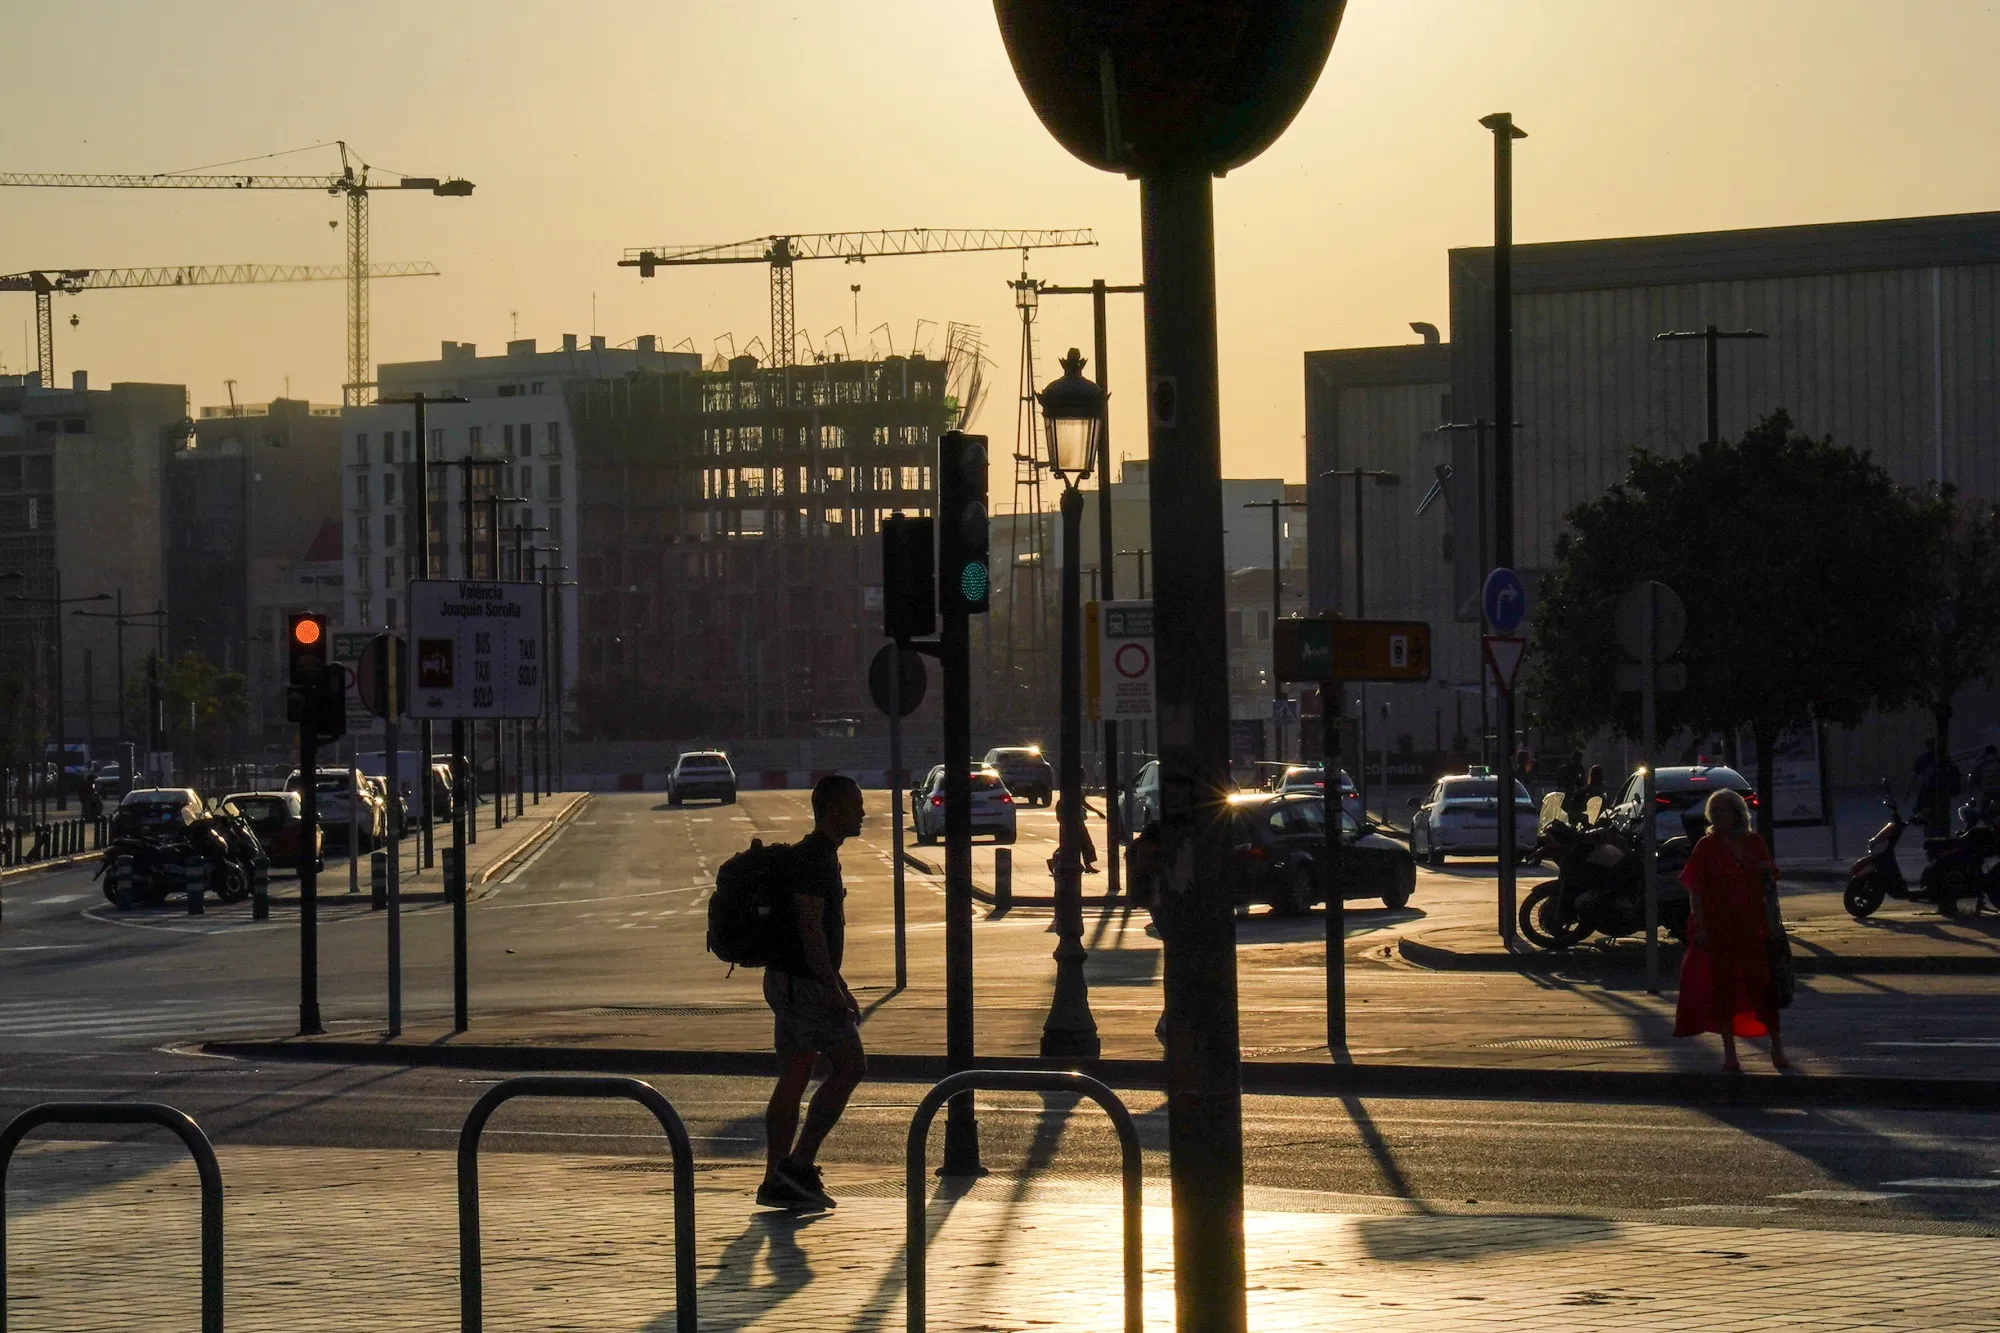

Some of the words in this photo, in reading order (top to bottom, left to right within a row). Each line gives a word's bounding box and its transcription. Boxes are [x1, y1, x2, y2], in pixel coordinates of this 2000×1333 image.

[485, 602, 521, 618] Sorolla
[475, 632, 490, 654] BUS
[519, 638, 536, 660] TAXI
[475, 660, 491, 682] TAXI
[518, 665, 537, 686] SOLO
[473, 686, 493, 708] SOLO
